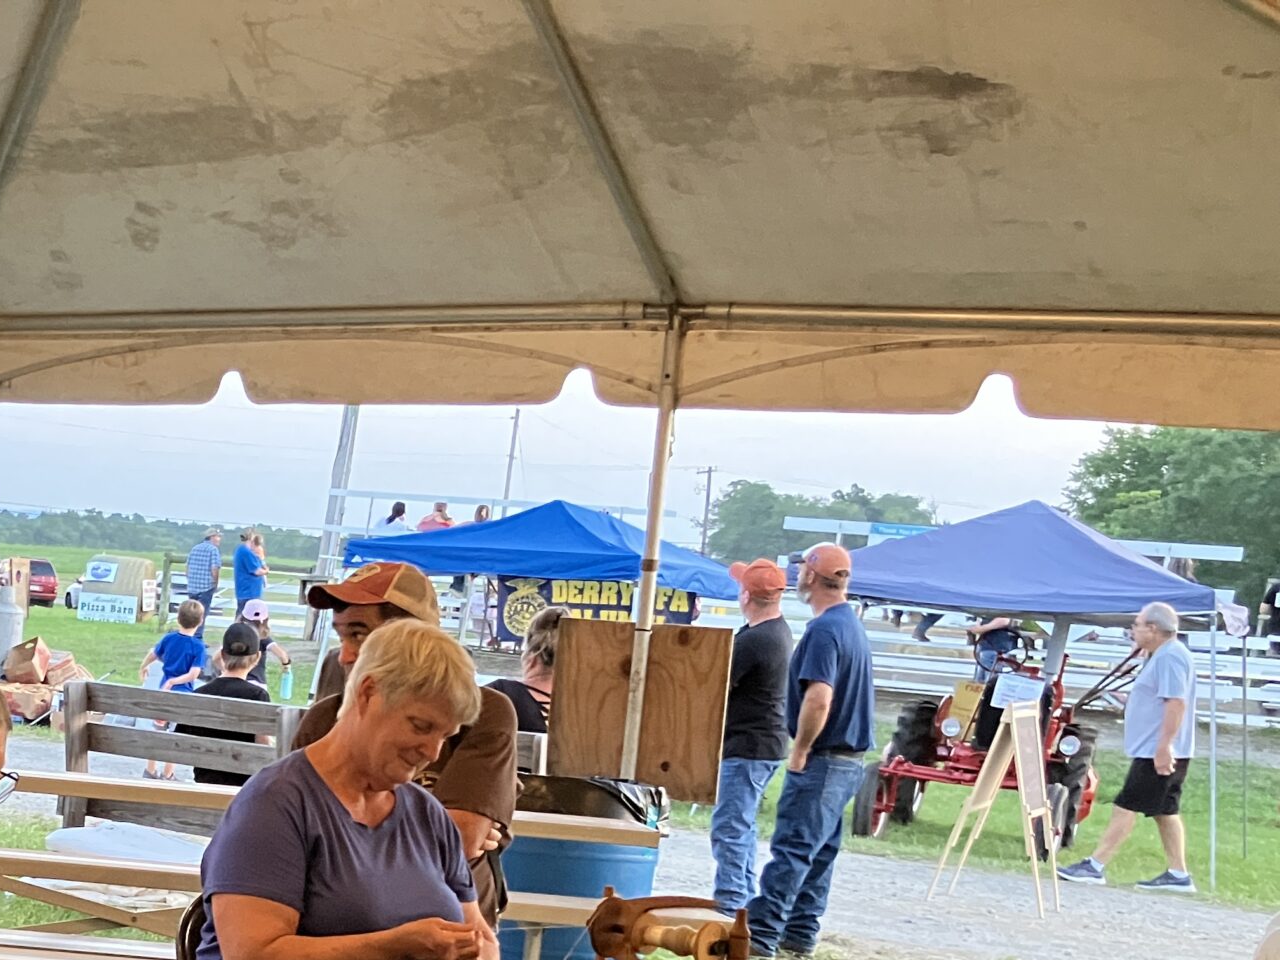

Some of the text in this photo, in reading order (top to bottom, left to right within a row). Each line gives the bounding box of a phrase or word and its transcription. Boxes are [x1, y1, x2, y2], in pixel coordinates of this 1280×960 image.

[551, 580, 633, 606] DERRY
[80, 602, 134, 614] Pizza Barn
